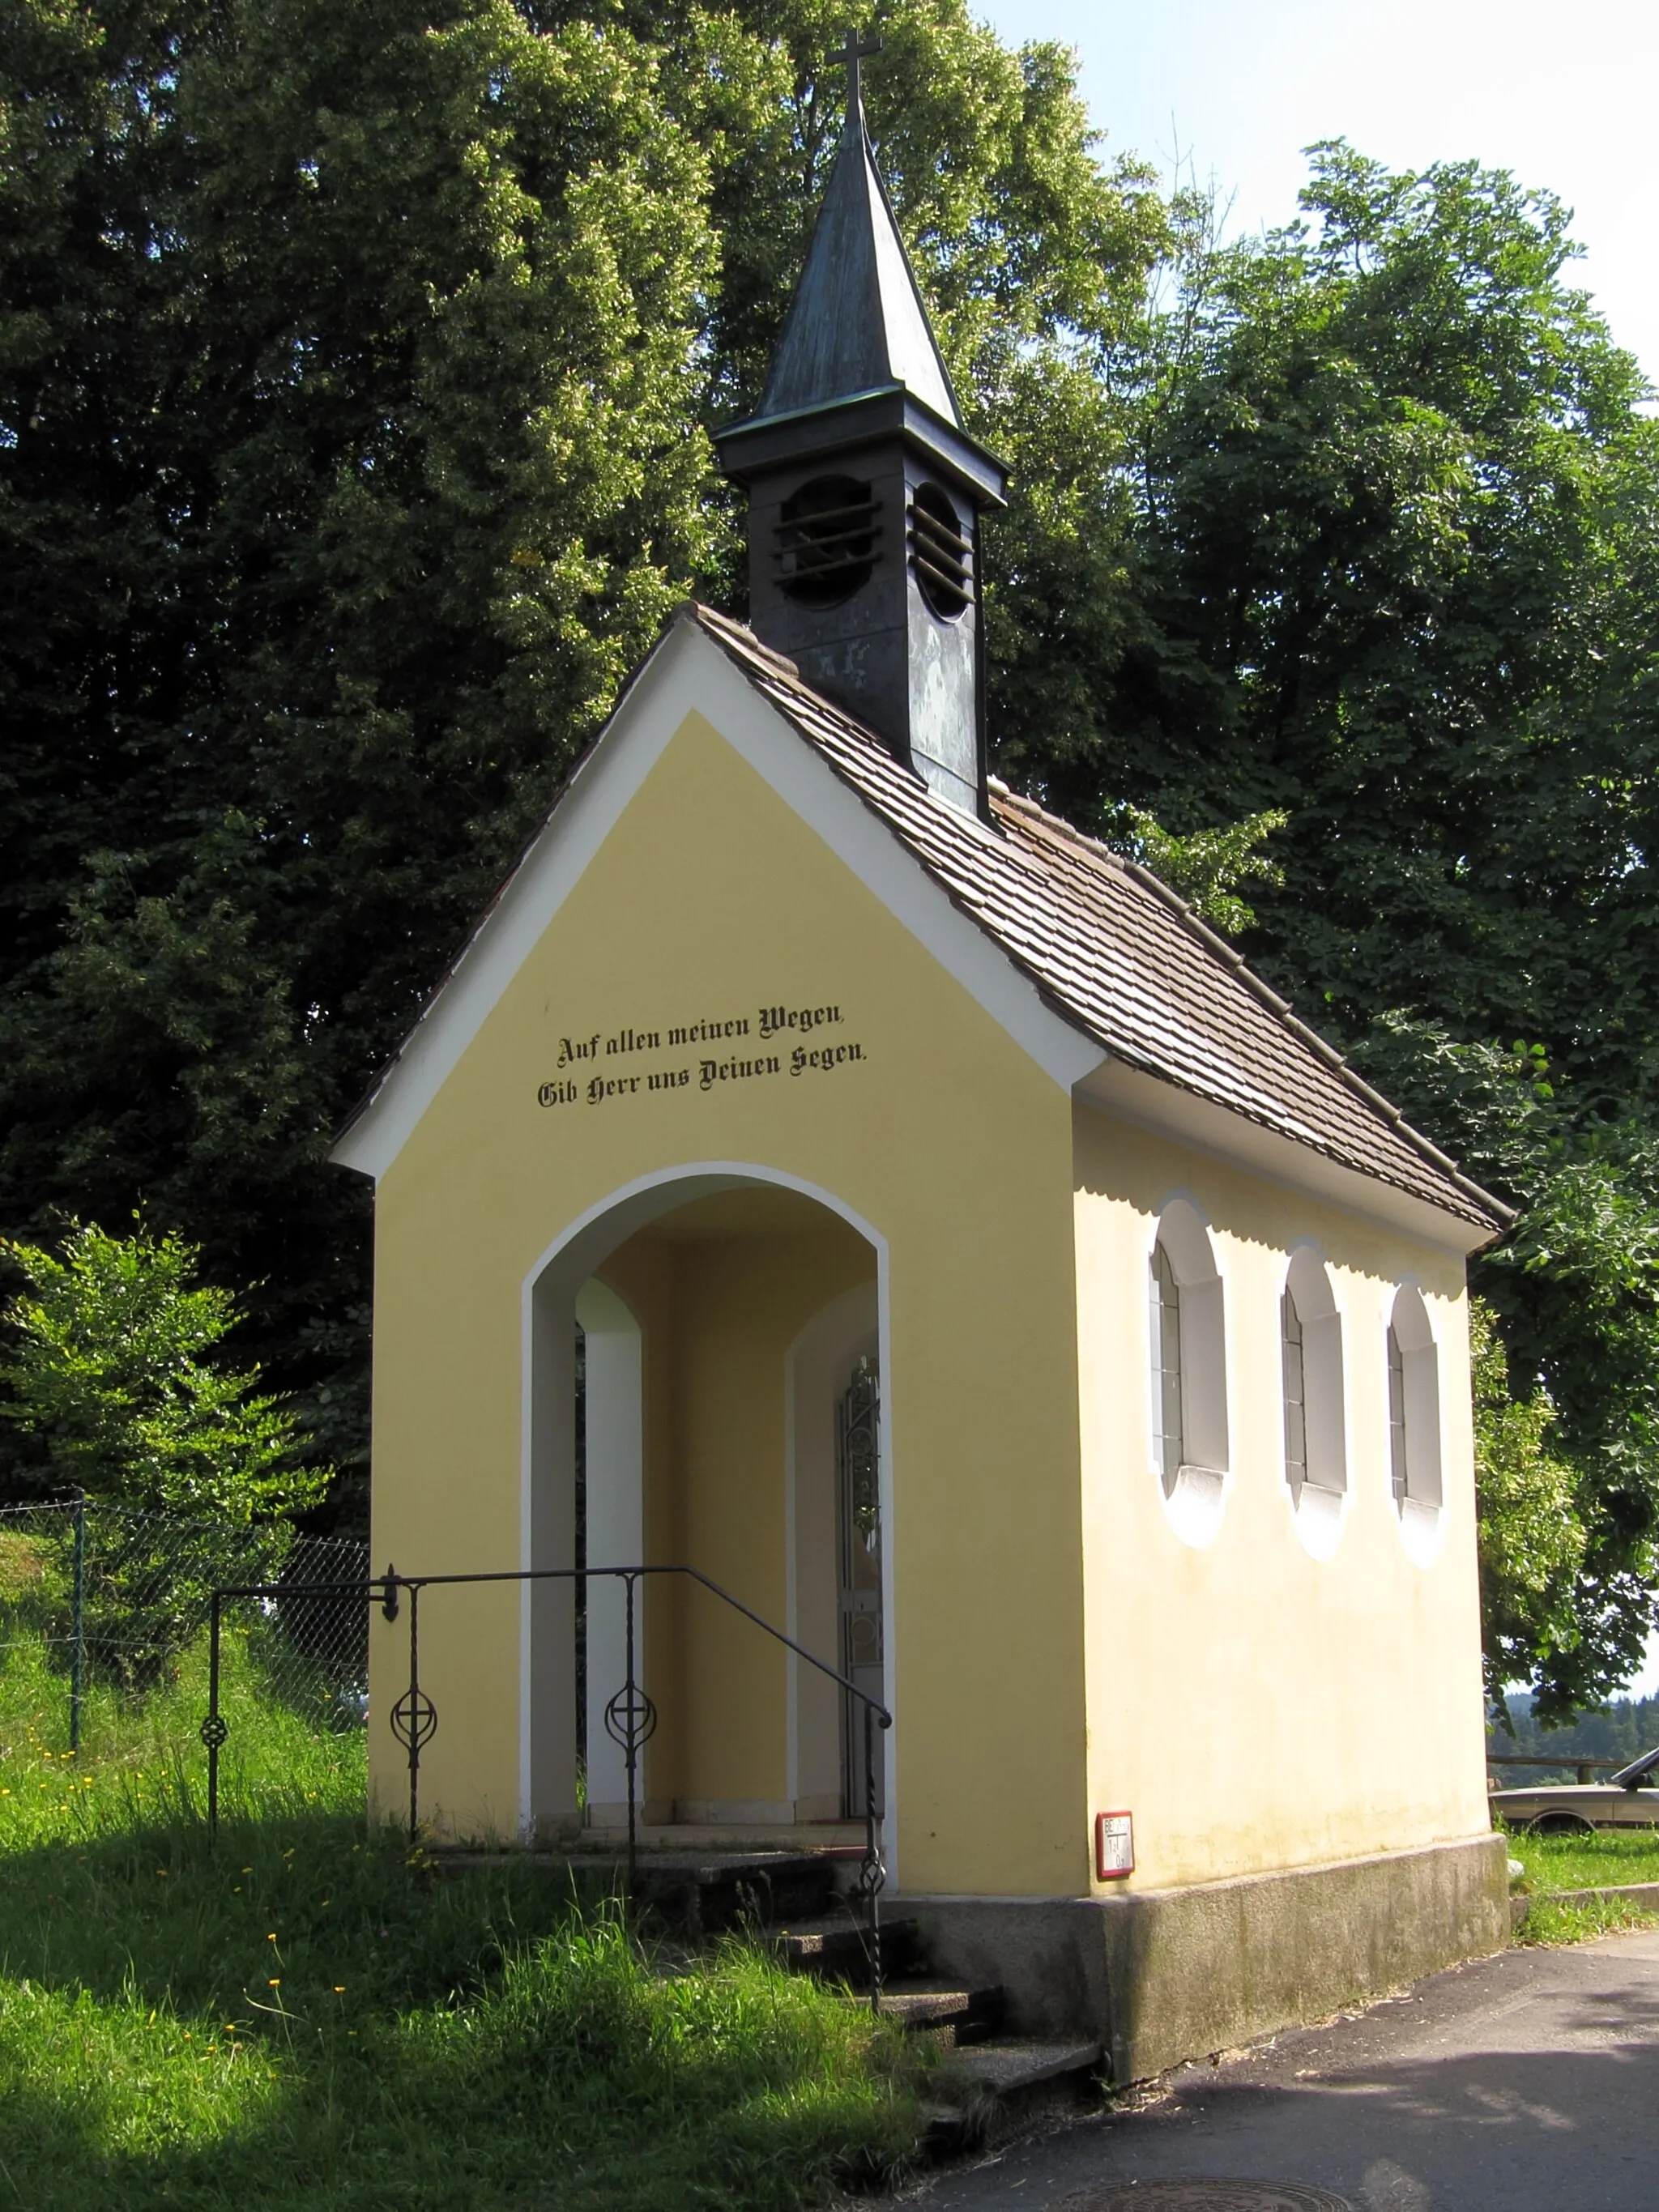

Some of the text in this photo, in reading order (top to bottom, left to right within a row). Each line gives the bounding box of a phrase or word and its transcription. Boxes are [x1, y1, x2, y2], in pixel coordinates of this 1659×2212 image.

[557, 1005, 845, 1069] Auf allen meinen Wegen,
[537, 1043, 868, 1108] Gib Herr uns Deinen Segen.
